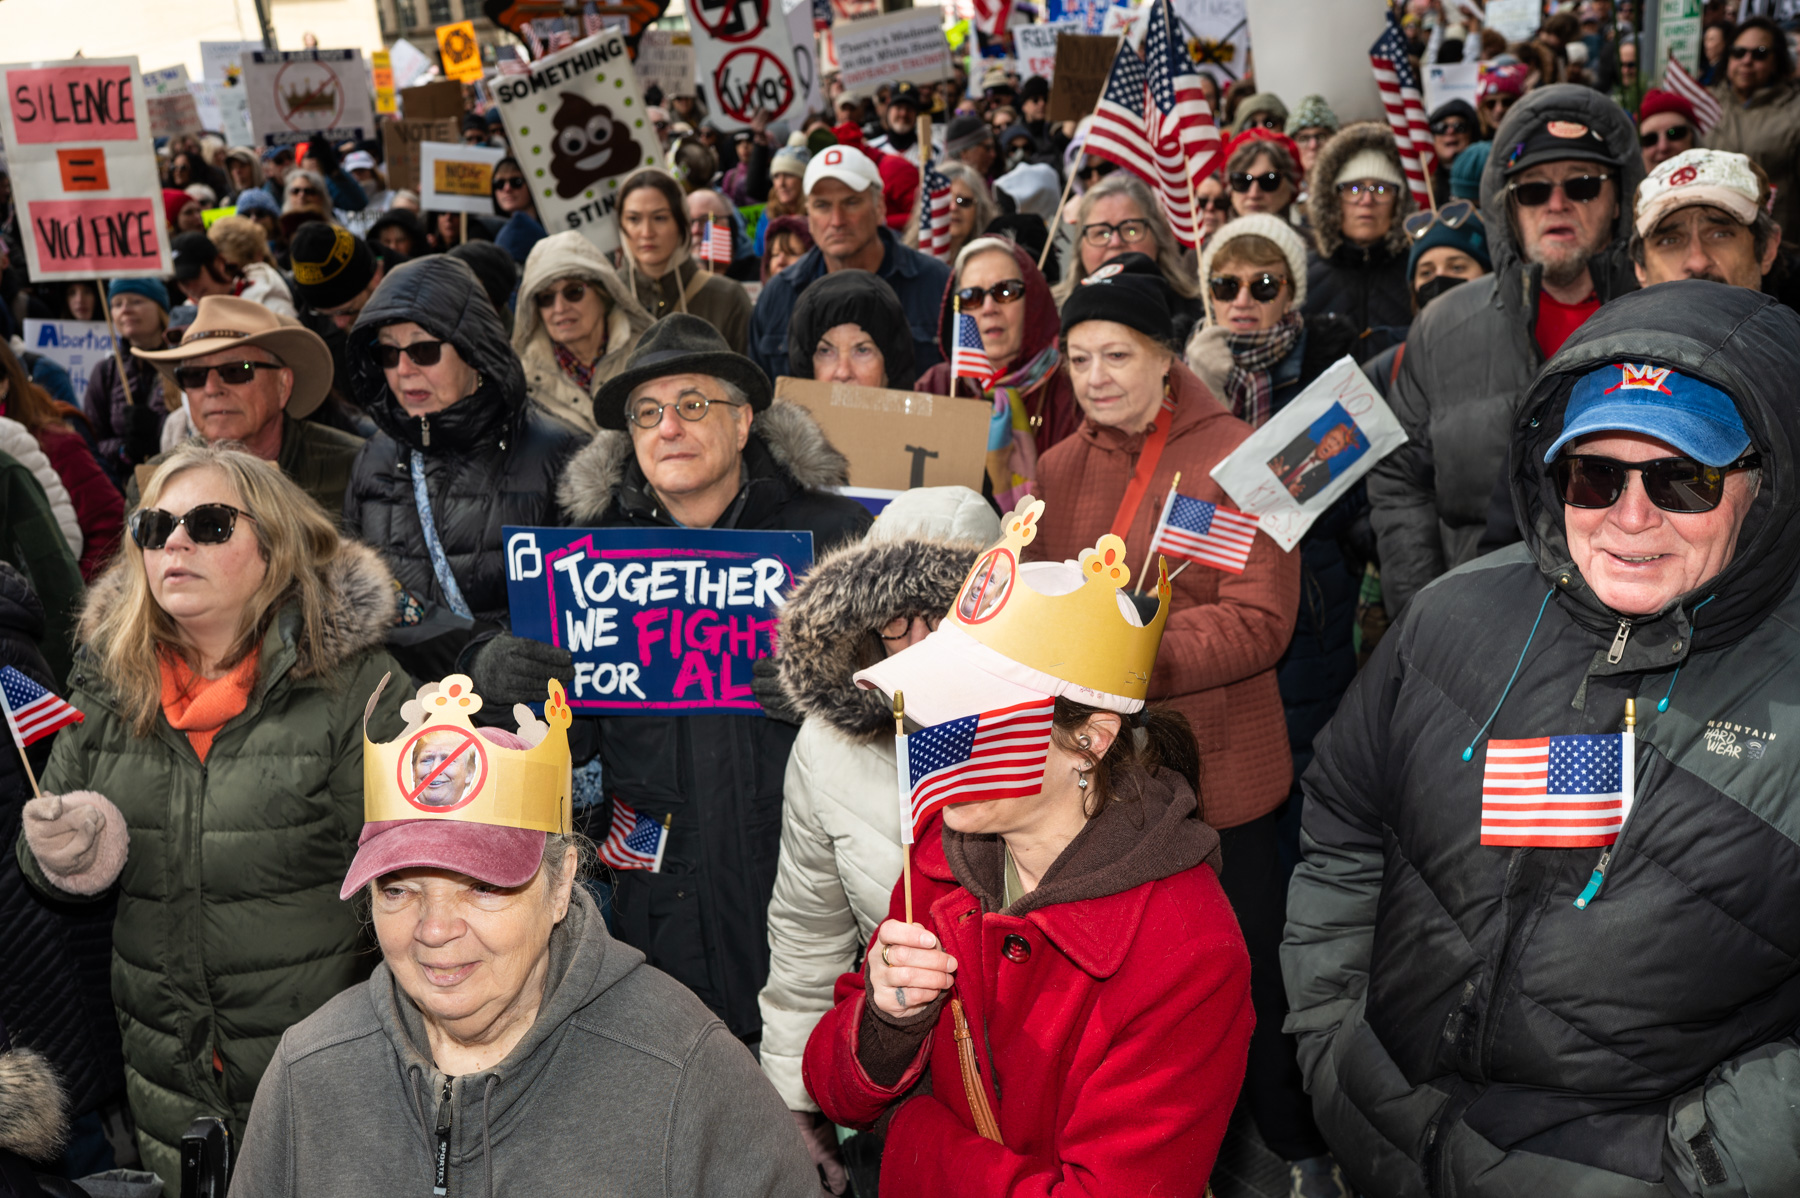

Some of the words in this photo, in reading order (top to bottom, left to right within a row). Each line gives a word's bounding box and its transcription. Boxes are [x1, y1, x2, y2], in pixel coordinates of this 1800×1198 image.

[499, 37, 624, 105] SOMETHING
[847, 64, 900, 83] IMPEACH
[857, 55, 874, 65] the
[877, 47, 908, 60] White
[16, 77, 135, 124] SILENCE
[394, 123, 449, 142] VOTE
[567, 194, 616, 229] STIN
[37, 210, 157, 261] VIOLENCE
[1333, 371, 1375, 417] NO
[554, 552, 786, 609] TOGETHER
[565, 607, 619, 652] WE
[574, 661, 646, 700] FOR
[672, 650, 754, 702] AL
[1704, 729, 1736, 744] HARD
[1706, 740, 1742, 759] WEAR
[1707, 720, 1776, 740] MOUNTAIN
[438, 1141, 447, 1185] SPORTEX
